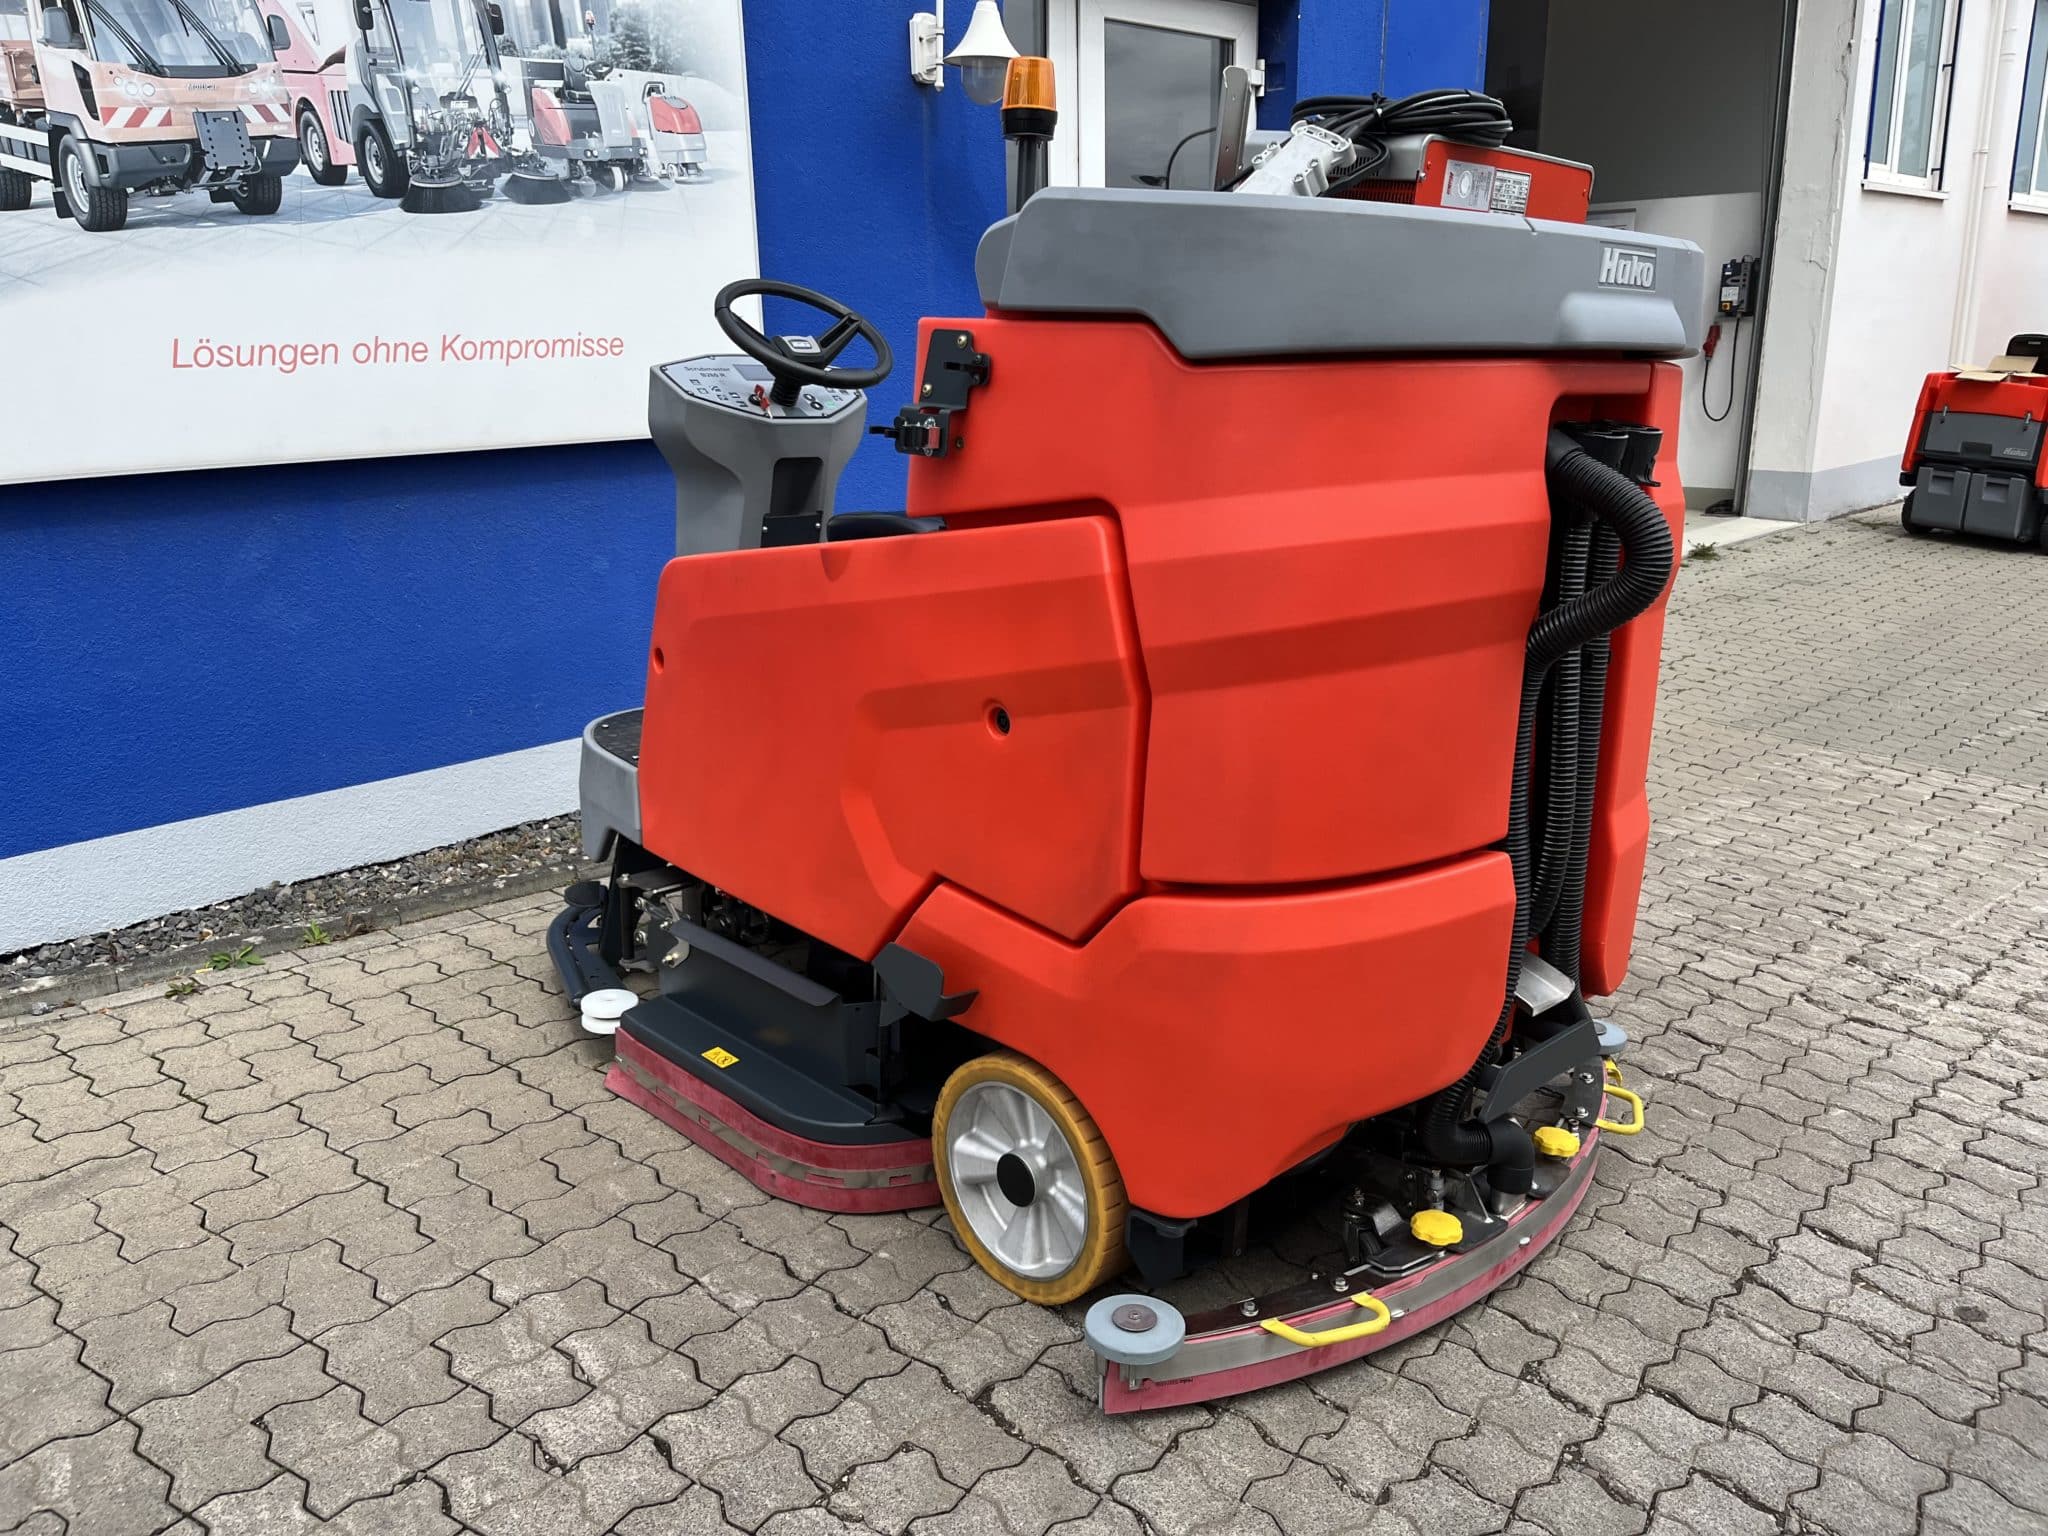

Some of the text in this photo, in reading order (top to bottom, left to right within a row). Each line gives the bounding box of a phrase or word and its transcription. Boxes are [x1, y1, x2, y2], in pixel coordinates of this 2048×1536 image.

[1599, 247, 1656, 288] Hako
[172, 331, 624, 374] Lösungen ohne Kompromisse
